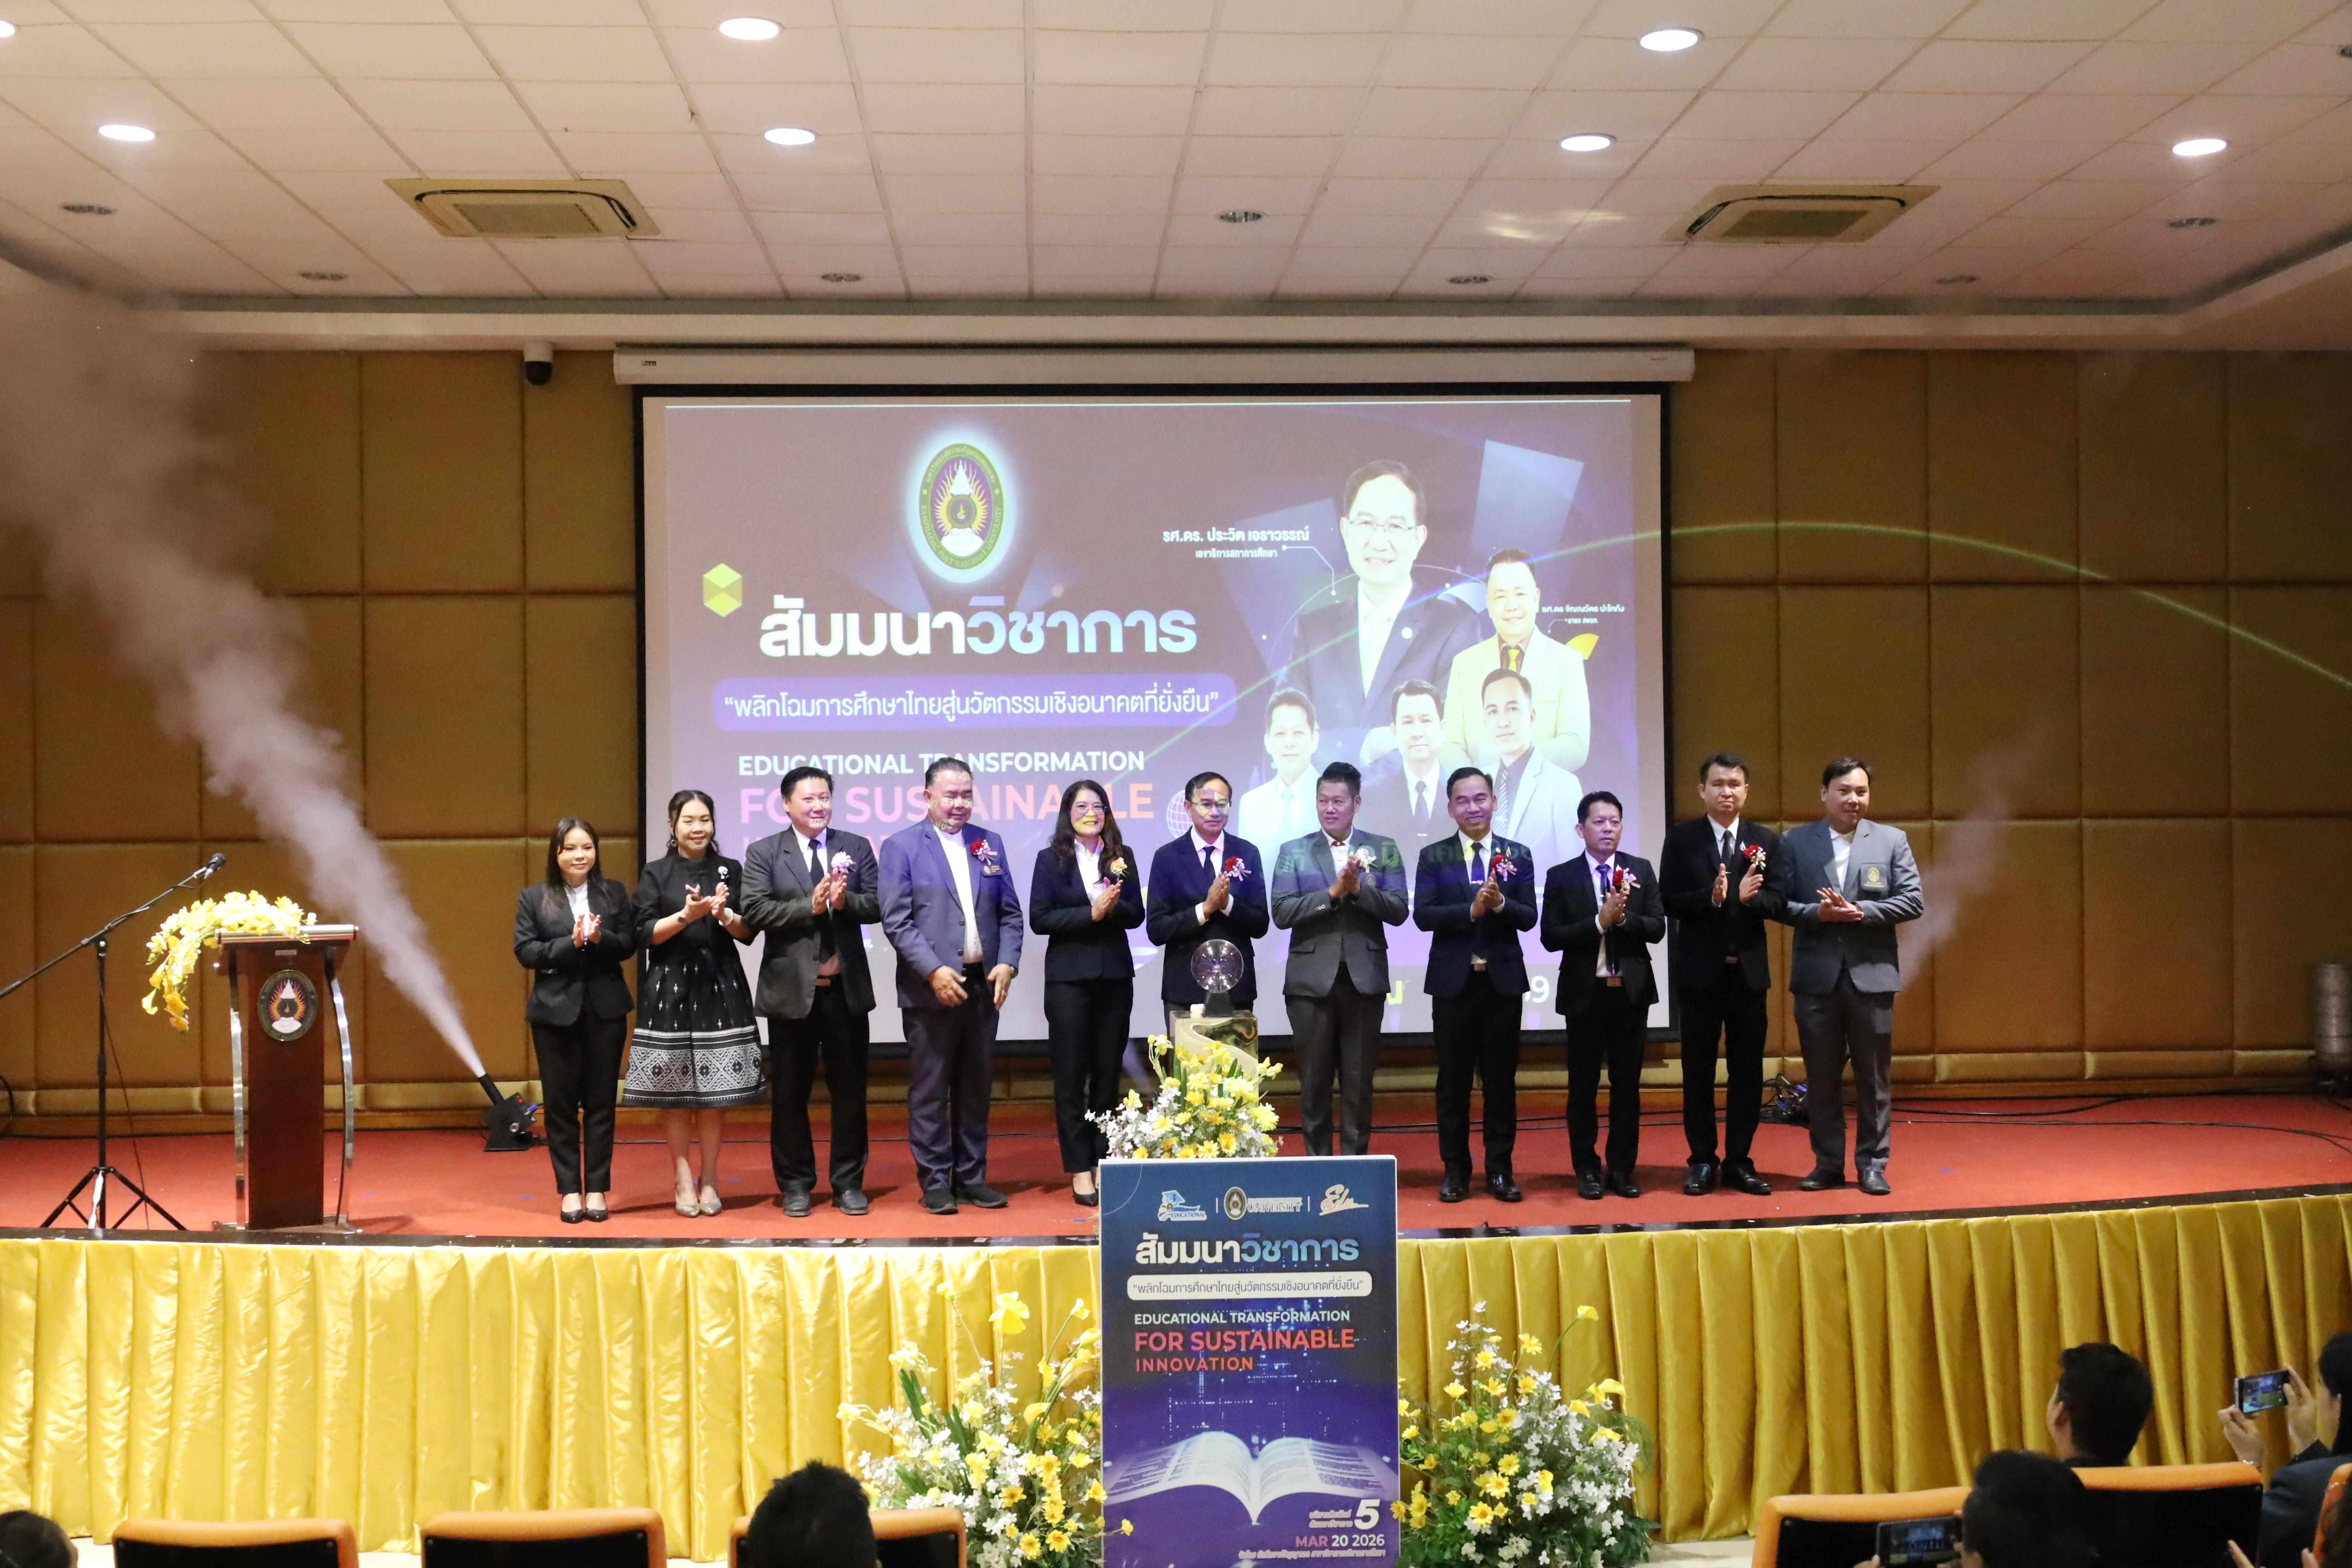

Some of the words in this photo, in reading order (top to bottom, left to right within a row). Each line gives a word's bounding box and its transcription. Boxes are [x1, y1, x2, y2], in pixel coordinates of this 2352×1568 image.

[1163, 530, 1204, 542] รศ.ดร.
[1207, 527, 1245, 542] ประวิต
[1248, 525, 1309, 542] เอราวรรณ์
[760, 594, 1197, 657] สัมมนาวิชาการ
[724, 682, 1218, 722] “พลิกโฉมการศึกษาไทยสู่นวัตกรรมเชิงอนาคตที่ยั่งยืน”
[919, 751, 1144, 773] TNSFORMATION
[1248, 1202, 1303, 1212] UNIVERSITY
[1135, 1232, 1359, 1264] สัมมนาวิชาการ
[1135, 1312, 1227, 1325] EDUCATIONAL
[1229, 1310, 1350, 1323] TRANSFORMATION
[1135, 1332, 1184, 1352] FOR
[1190, 1329, 1355, 1351] SUSTAINABLE
[1136, 1357, 1253, 1372] INNOVATION
[1354, 1499, 1380, 1530] 5
[1295, 1535, 1328, 1547] MAR
[1331, 1534, 1349, 1547] 20
[1352, 1534, 1385, 1547] 2026
